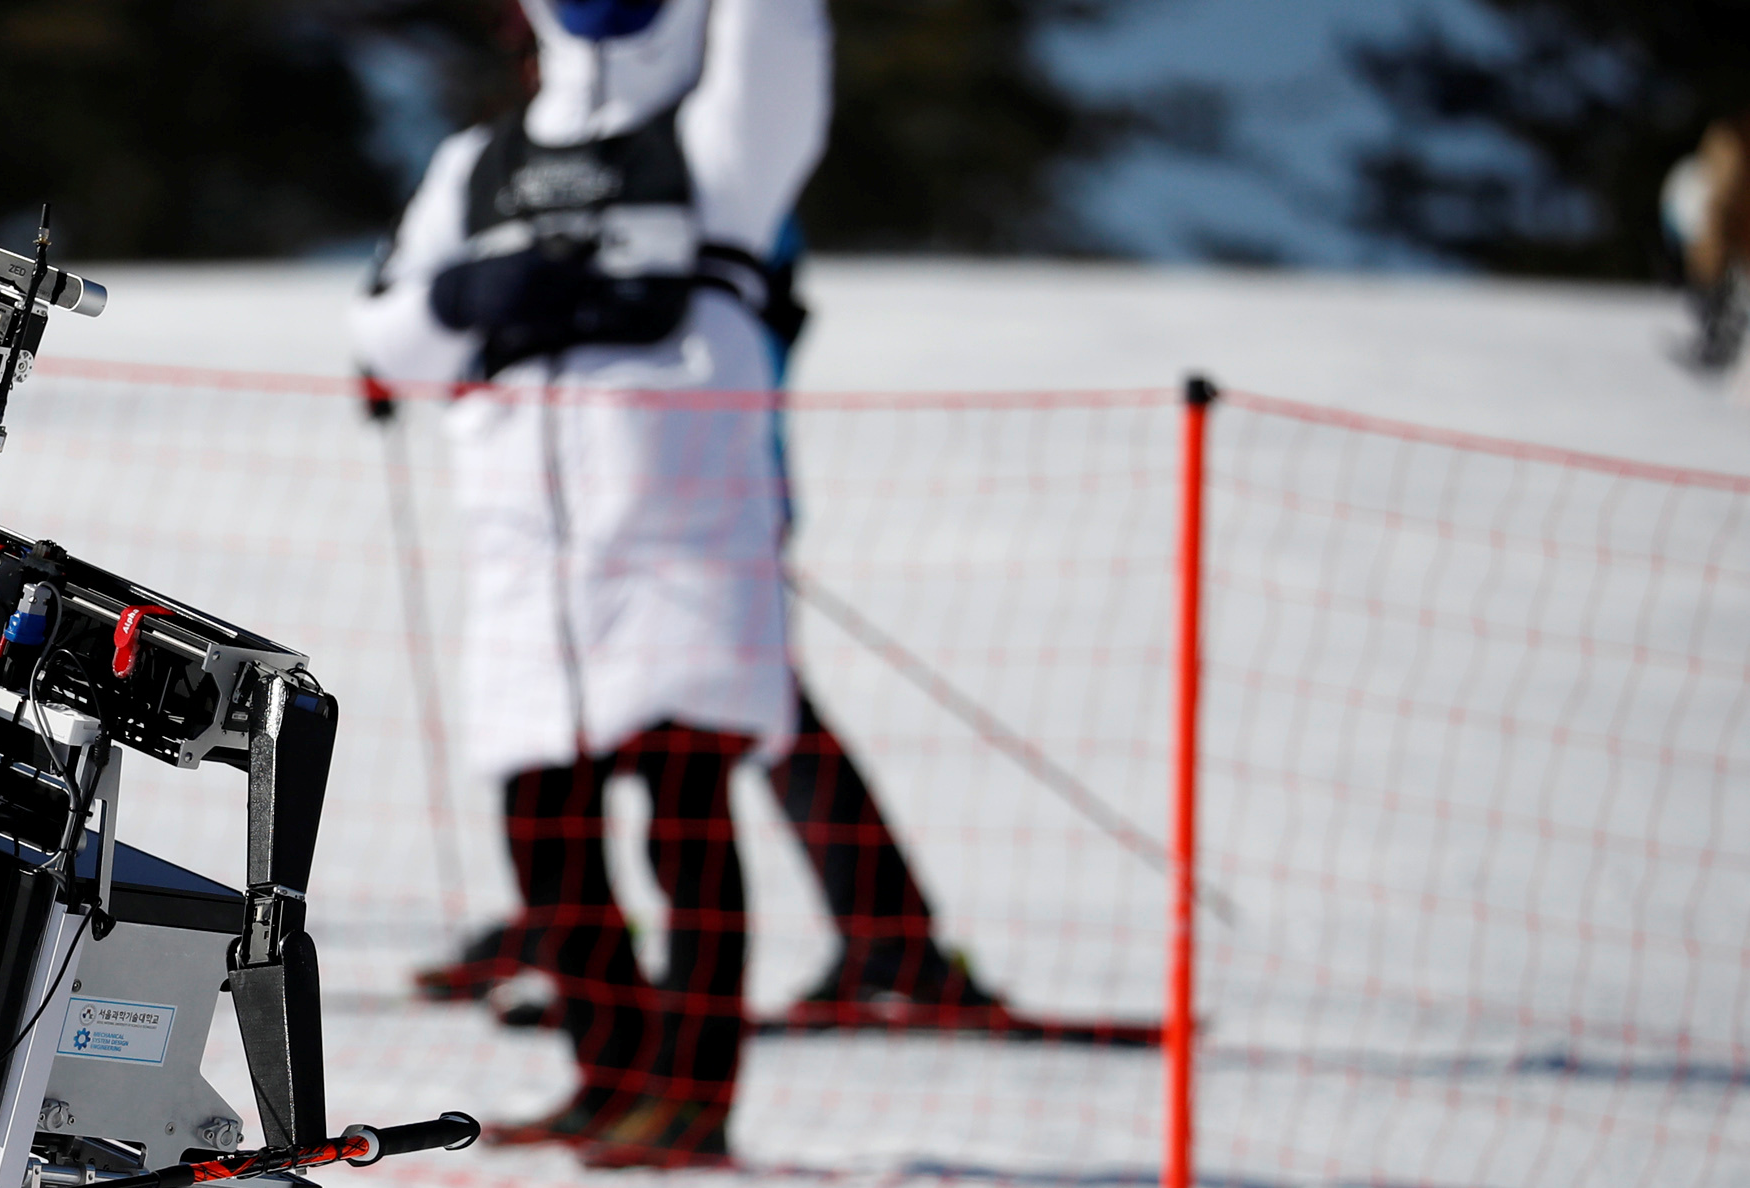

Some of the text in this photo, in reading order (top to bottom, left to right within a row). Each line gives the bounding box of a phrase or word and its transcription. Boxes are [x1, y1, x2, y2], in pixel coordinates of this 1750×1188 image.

[8, 264, 27, 276] ZED
[122, 608, 140, 634] Alpha
[98, 1009, 160, 1025] 서울과학기술대학교
[93, 1032, 125, 1040] MECHANICAL
